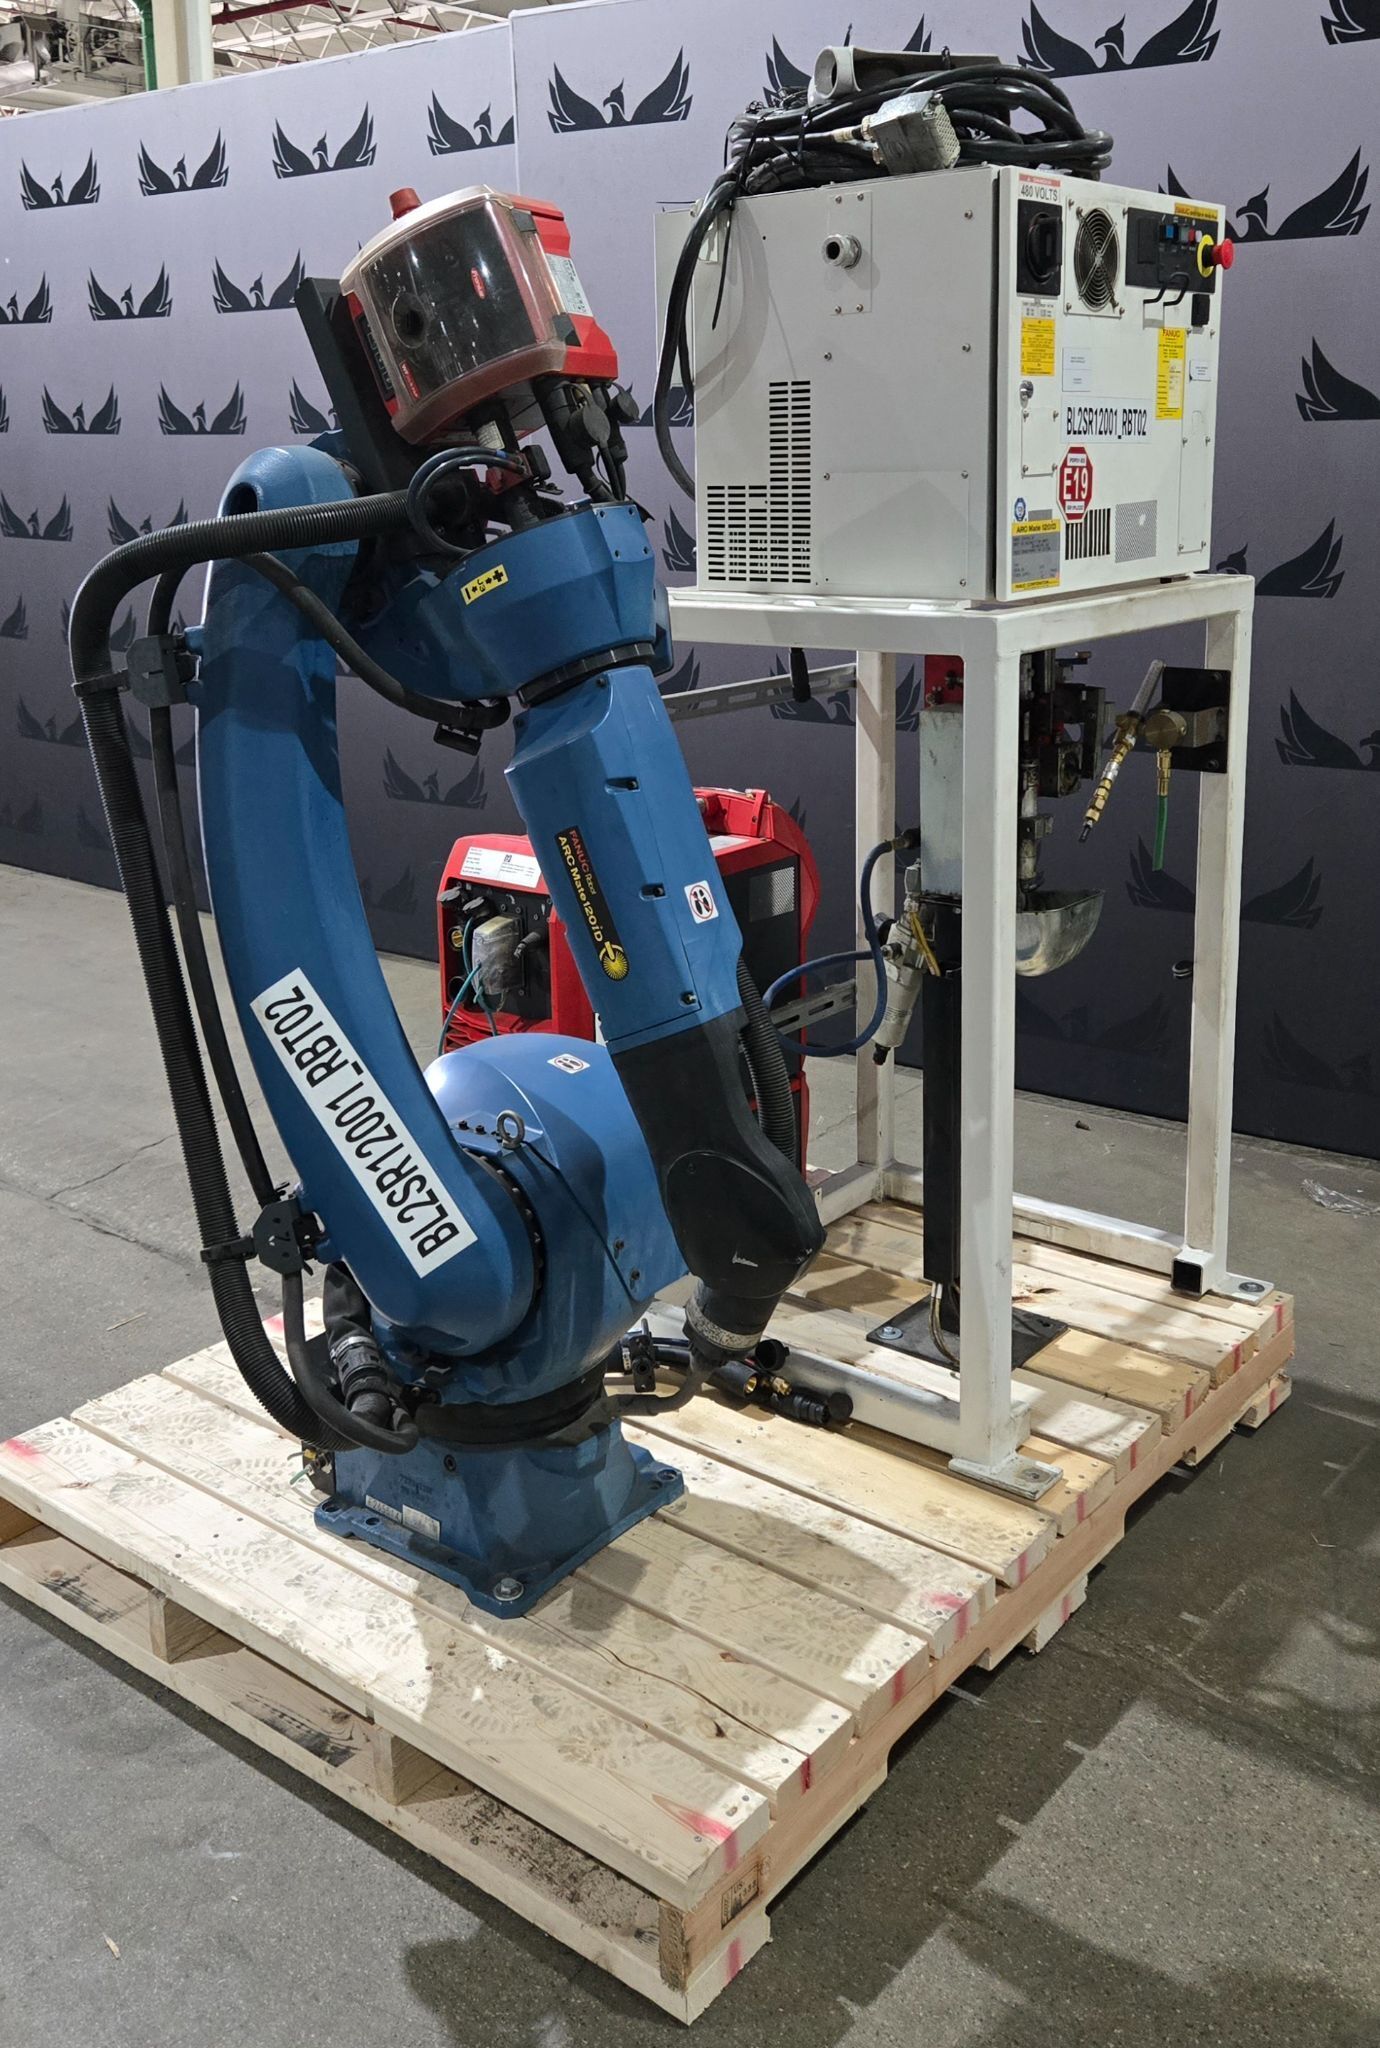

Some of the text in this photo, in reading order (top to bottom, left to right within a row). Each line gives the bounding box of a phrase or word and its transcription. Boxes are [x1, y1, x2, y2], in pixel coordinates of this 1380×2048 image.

[1021, 184, 1058, 202] 480 VOLTS
[1163, 328, 1181, 337] FANUC
[1067, 407, 1148, 440] BL2SR12001_RBT02
[1063, 467, 1089, 500] E19
[1016, 525, 1028, 534] ARC
[558, 836, 575, 867] ARC
[568, 830, 590, 873] FANUC
[264, 985, 460, 1259] BL2SR12001_RBT02
